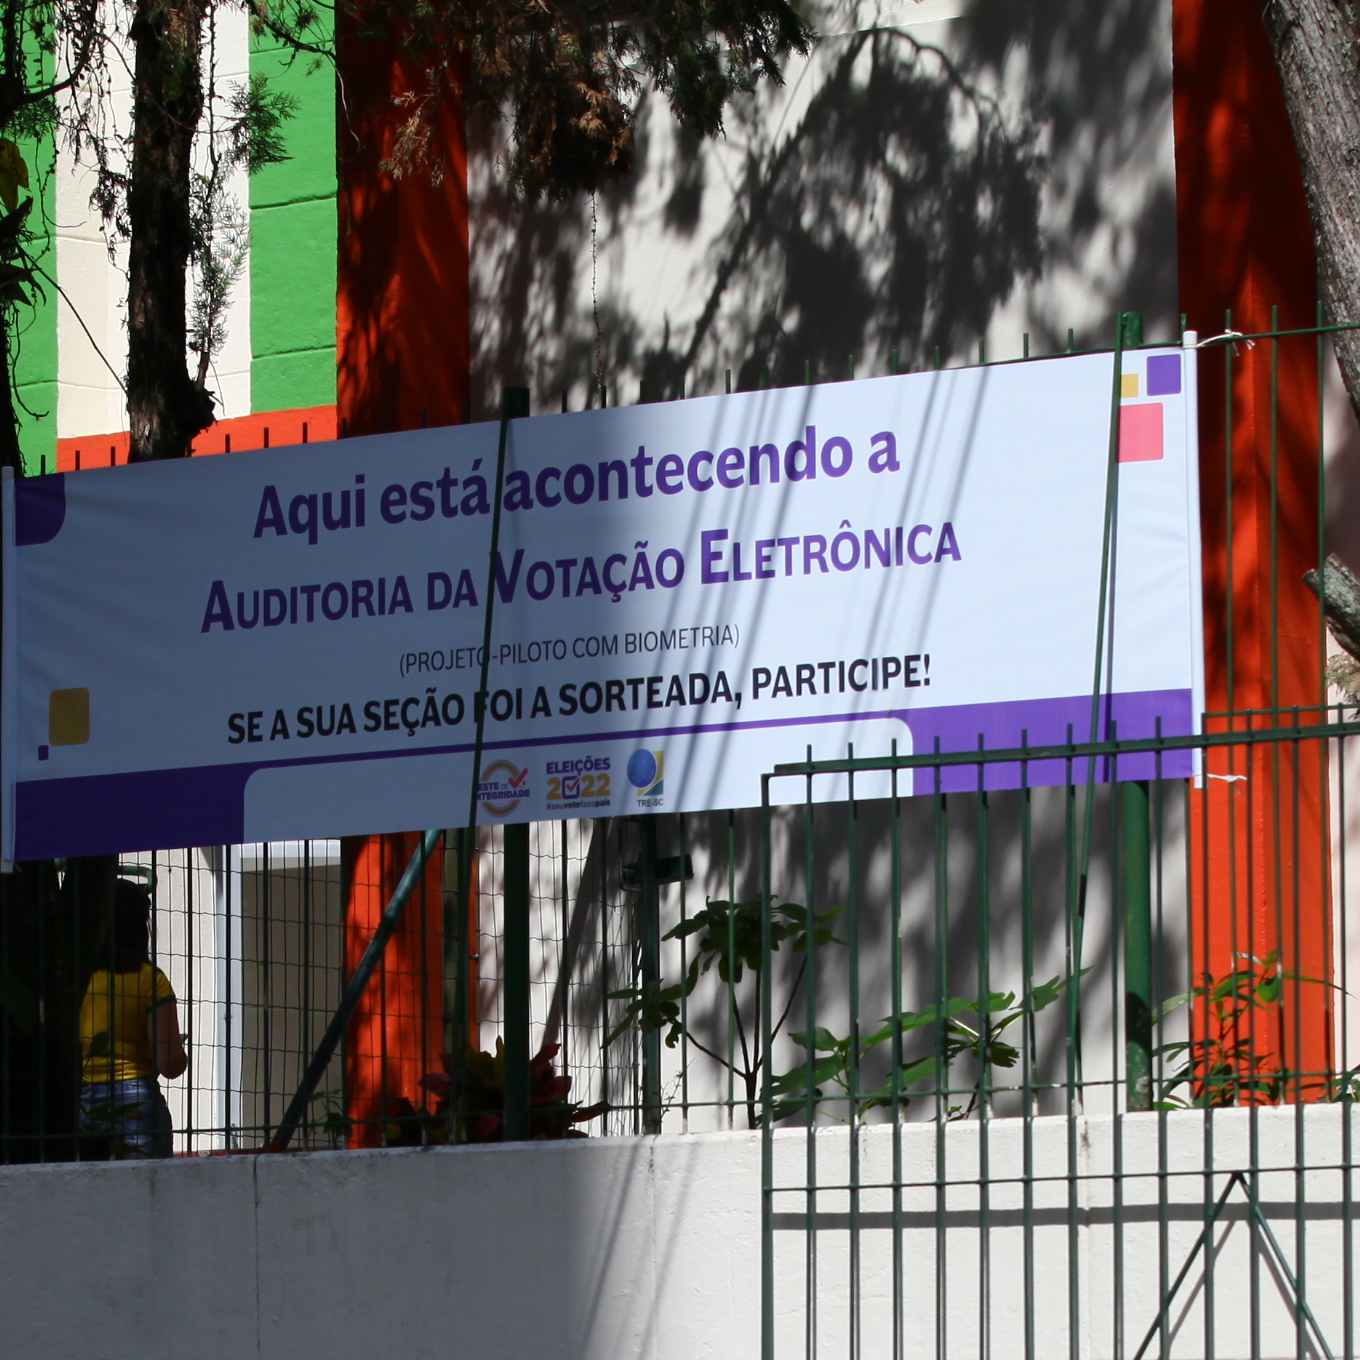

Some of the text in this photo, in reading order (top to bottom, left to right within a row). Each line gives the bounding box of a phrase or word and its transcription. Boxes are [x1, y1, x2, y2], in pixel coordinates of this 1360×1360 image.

[253, 425, 900, 545] Aqui está acontecendo a
[200, 519, 962, 633] AUDITORIA DA VOTAÇÃO ELETRÔNICA
[572, 634, 618, 658] COM
[624, 622, 741, 654] BIOMETRIA)
[228, 655, 931, 744] SE A SUA SEÇÃO FOI A SORTEADA, PARTICIPE!
[546, 755, 611, 776] ELEIÇÕES
[477, 782, 499, 791] ESTE
[477, 788, 530, 801] NTEGRIDADE
[637, 798, 664, 808] TRE-SC
